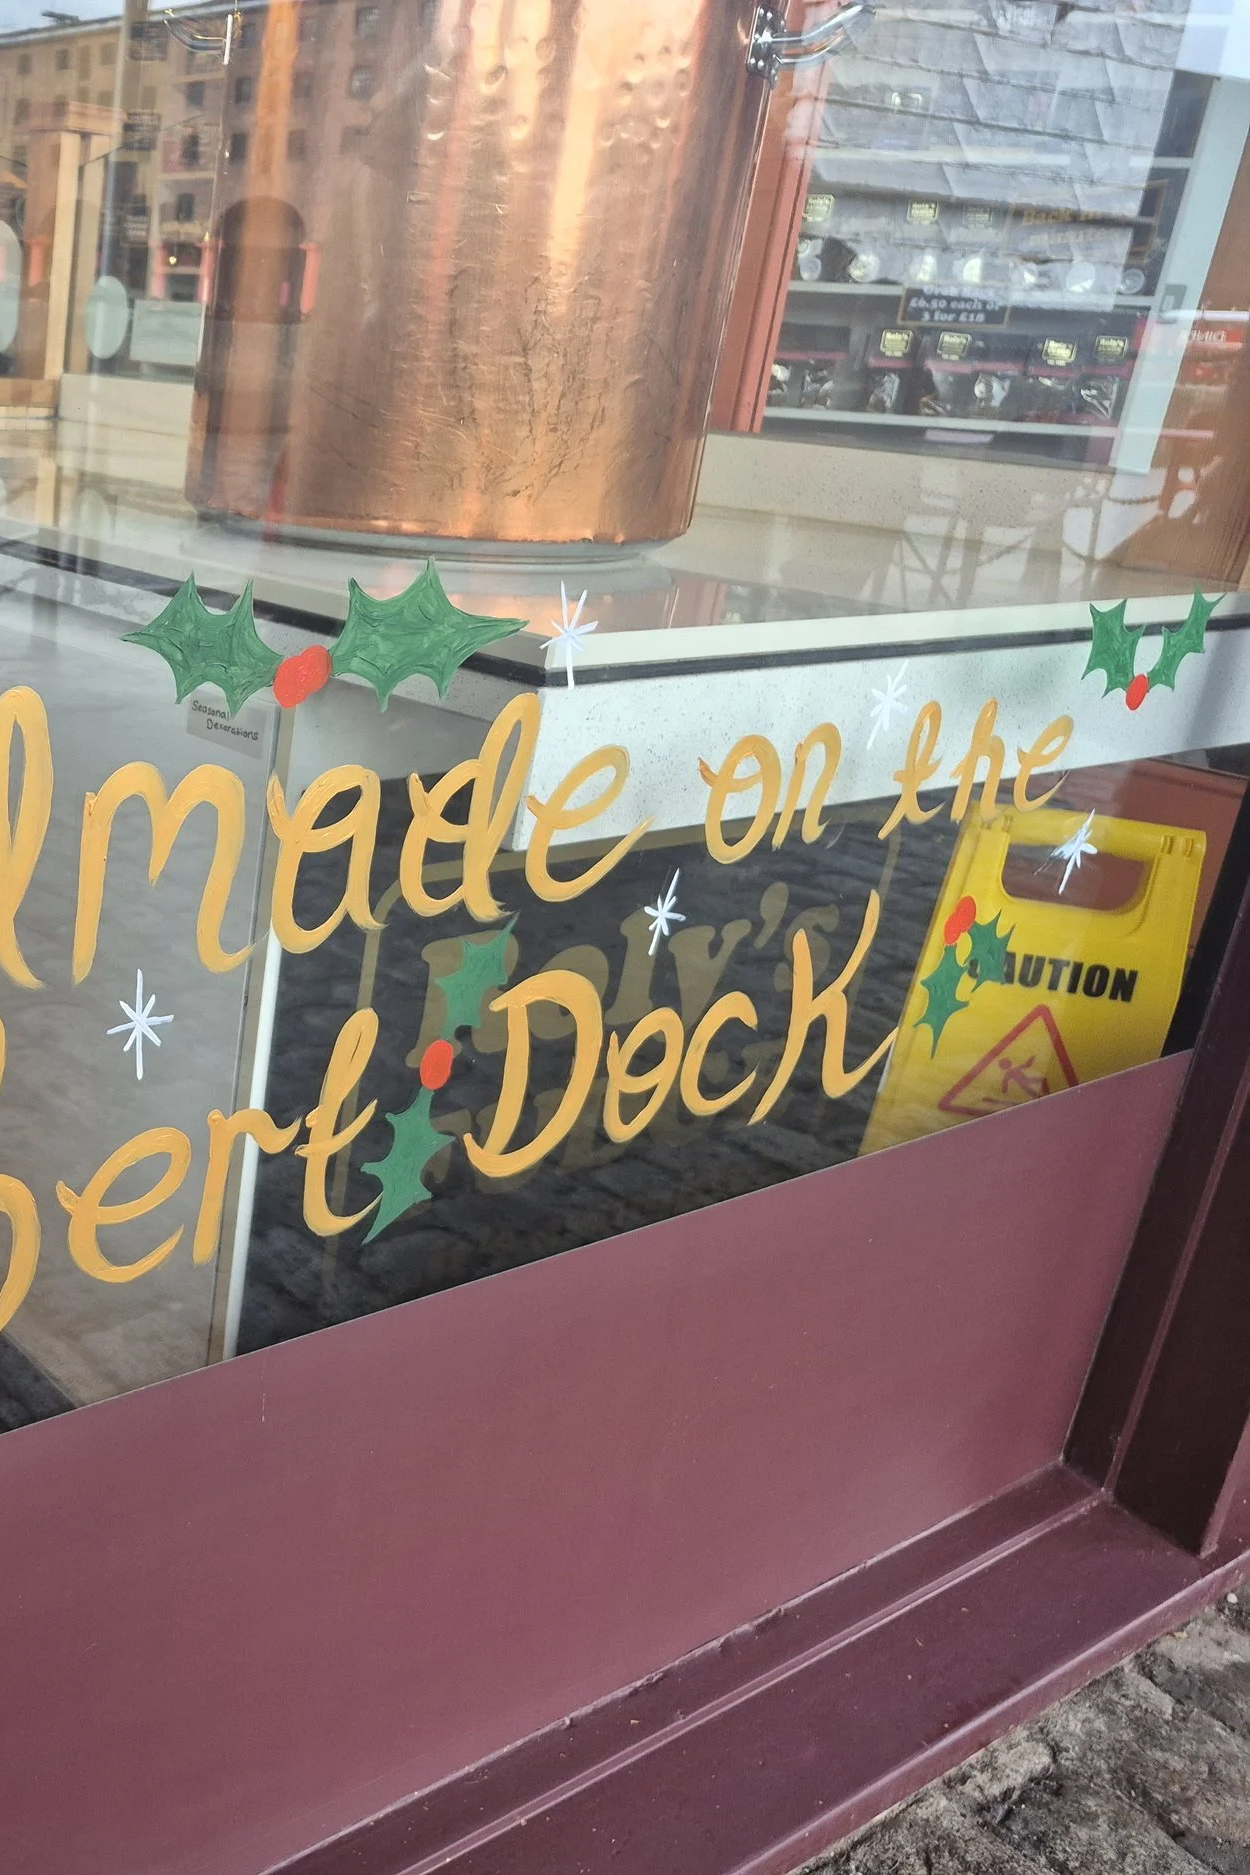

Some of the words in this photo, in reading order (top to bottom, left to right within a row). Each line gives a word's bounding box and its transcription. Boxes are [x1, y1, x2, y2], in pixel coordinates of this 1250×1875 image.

[933, 310, 957, 321] for
[191, 700, 230, 721] Seasonal
[206, 719, 259, 740] Decorations
[698, 720, 842, 864] on
[879, 698, 1076, 839] the
[968, 951, 1139, 1003] AUTION
